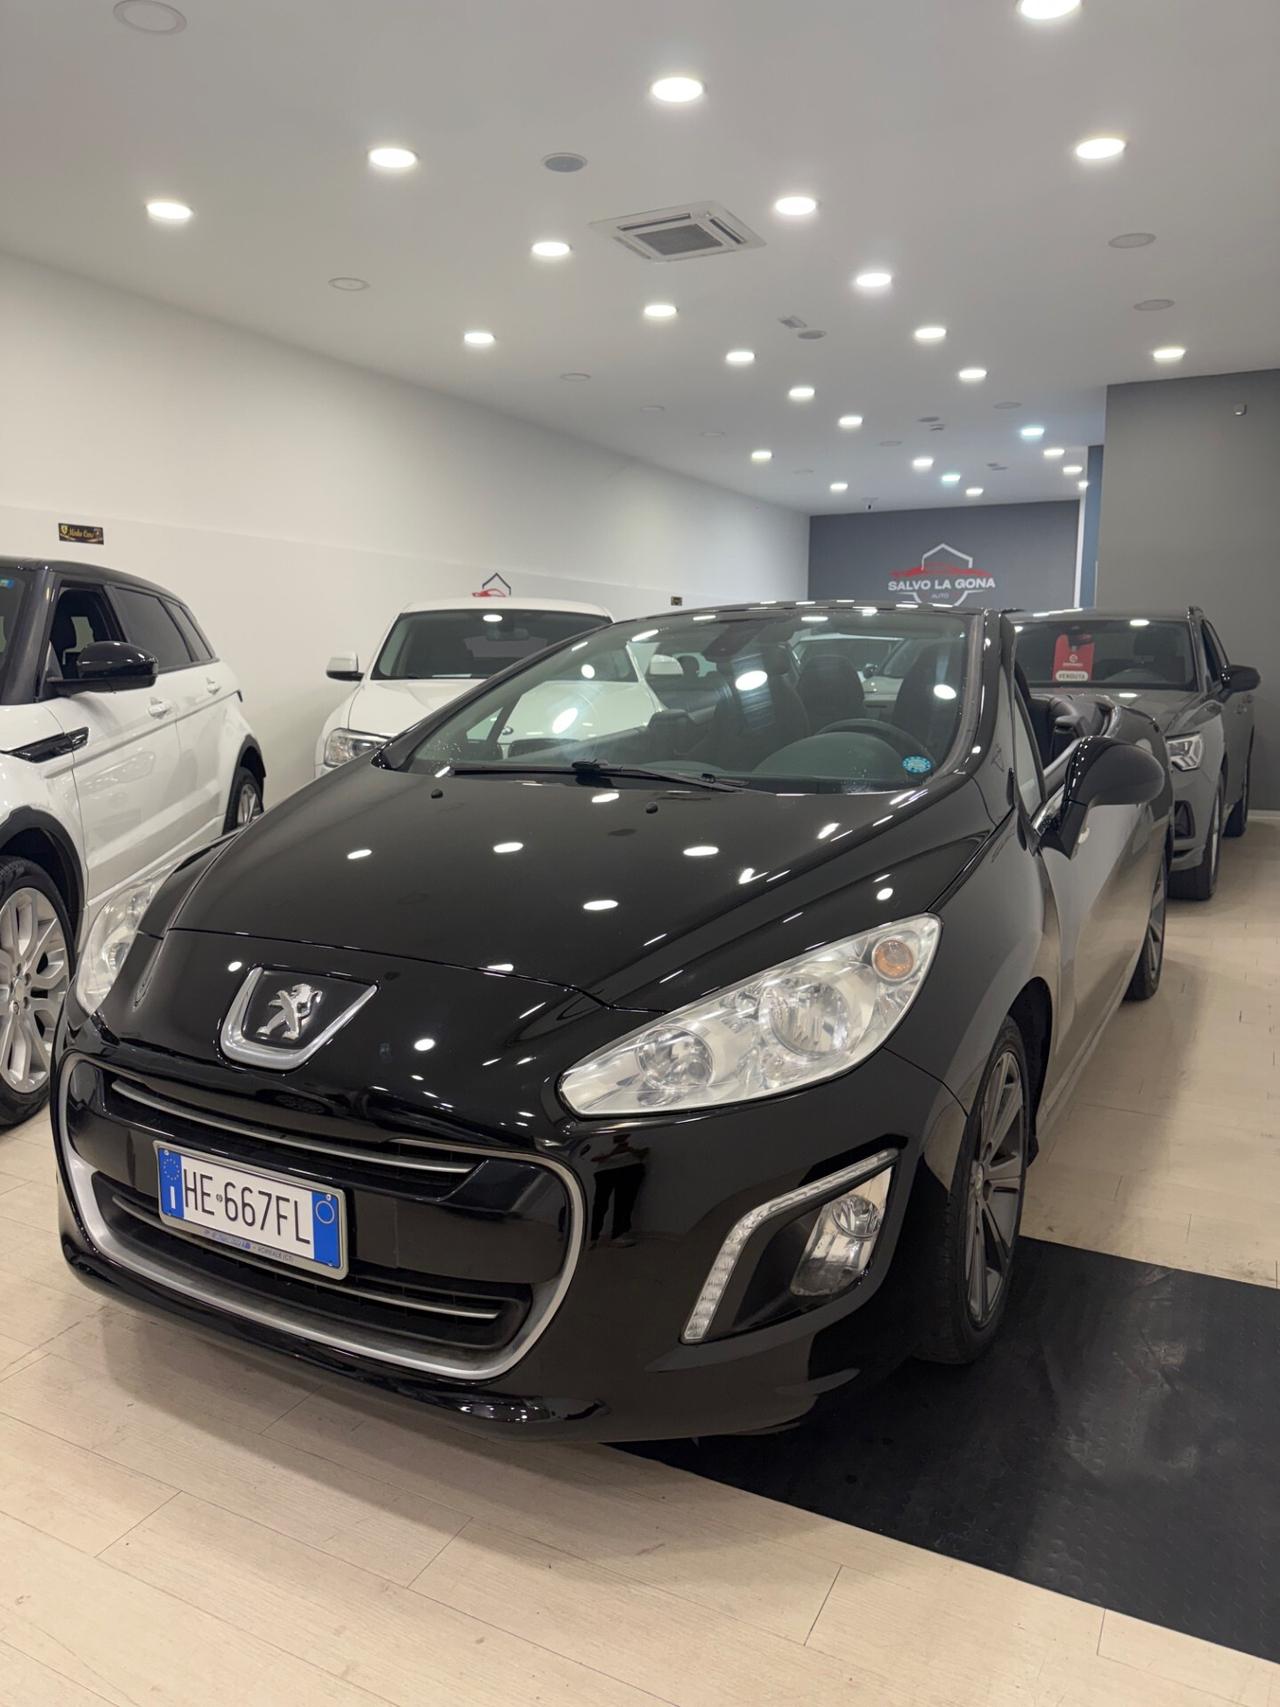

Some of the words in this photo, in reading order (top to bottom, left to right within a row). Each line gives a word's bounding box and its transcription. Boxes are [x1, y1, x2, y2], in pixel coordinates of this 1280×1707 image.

[887, 580, 931, 591] SALVO
[934, 580, 951, 590] LA
[955, 578, 995, 589] GONA
[183, 1168, 215, 1216] HE
[223, 1181, 311, 1245] 667FL
